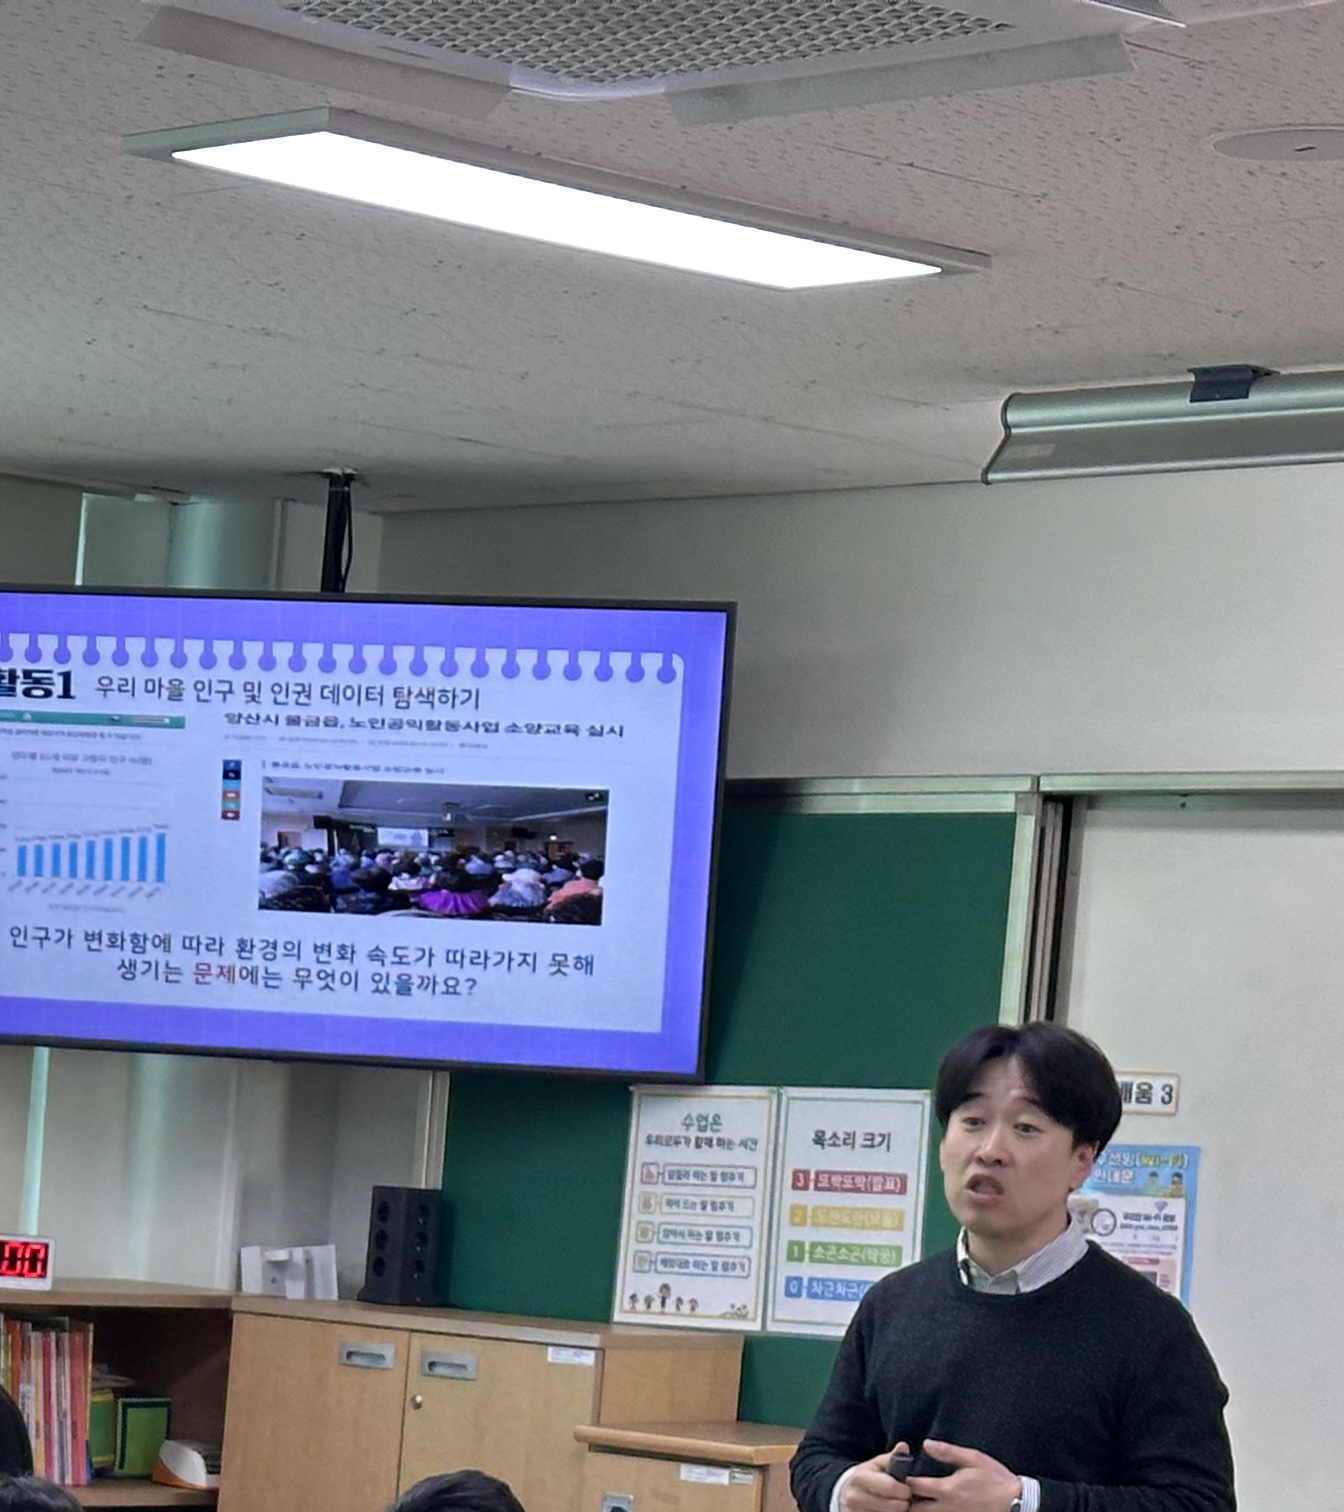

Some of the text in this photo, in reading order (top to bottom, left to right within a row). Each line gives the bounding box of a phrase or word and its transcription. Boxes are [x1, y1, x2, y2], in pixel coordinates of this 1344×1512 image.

[95, 674, 481, 711] 우리 마을 인구 및 인권 데이터 탐색하기
[9, 925, 595, 977] 인구가 변화함에 따라 환경의 변화 속도가 따라가지 못해
[117, 958, 478, 997] 생기는 문제에는 무엇이 있을까요?
[1160, 1083, 1174, 1105] 3
[681, 1113, 723, 1133] 수업은
[812, 1130, 892, 1152] 목소리 크기
[796, 1172, 805, 1188] 3
